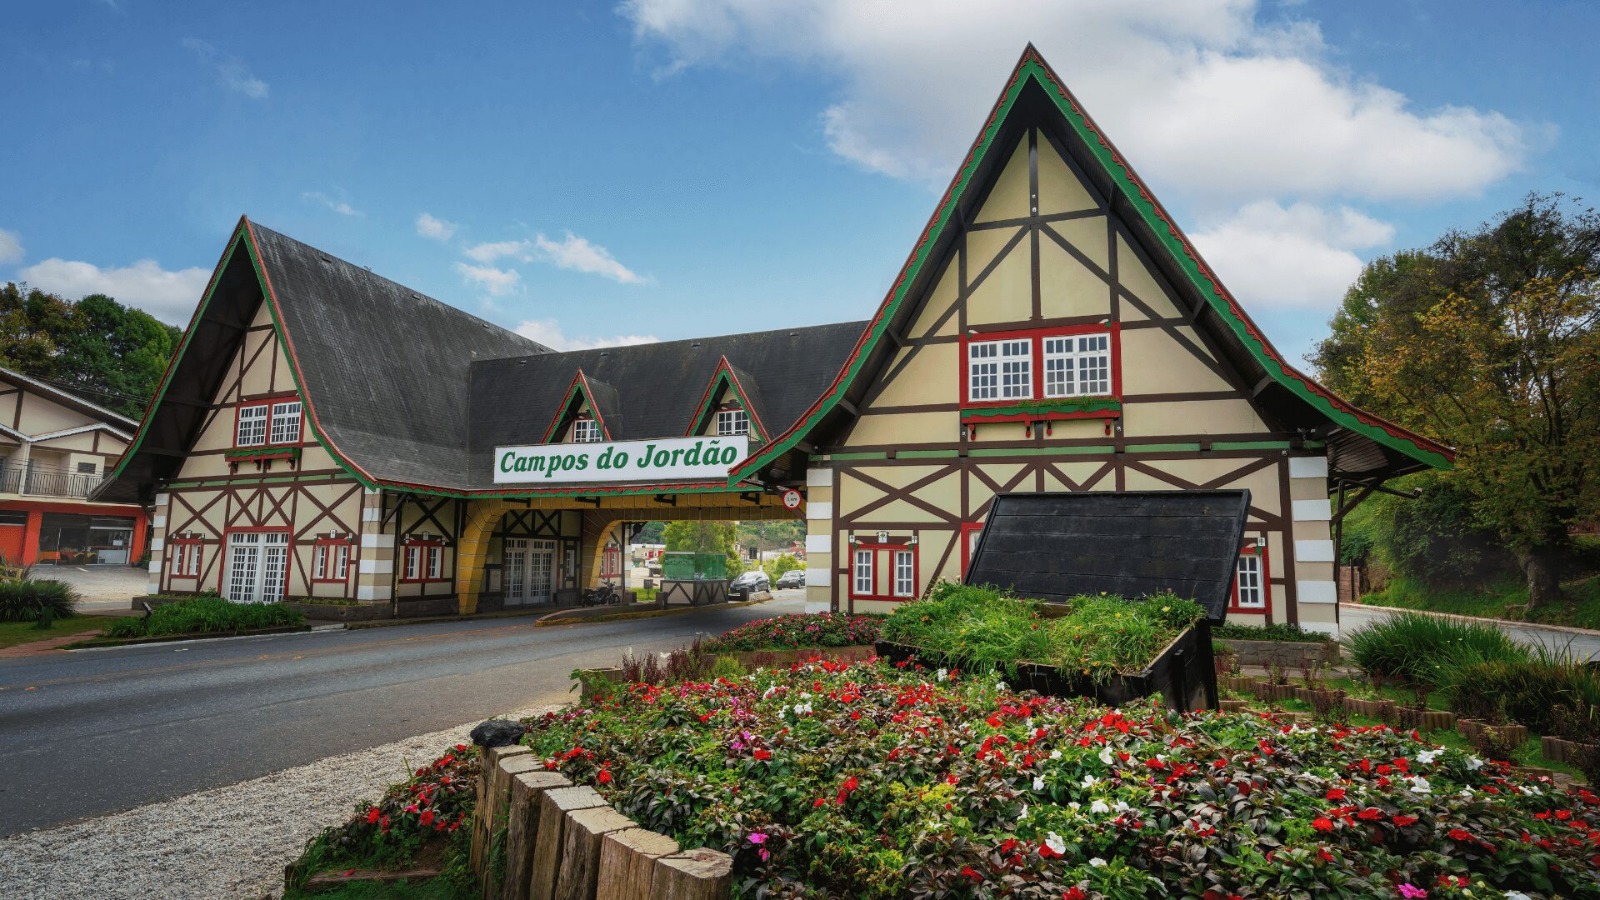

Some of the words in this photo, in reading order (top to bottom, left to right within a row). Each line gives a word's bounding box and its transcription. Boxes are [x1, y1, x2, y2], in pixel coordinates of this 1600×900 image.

[500, 451, 589, 478] Campos
[596, 446, 629, 470] do
[637, 440, 738, 469] Jordão
